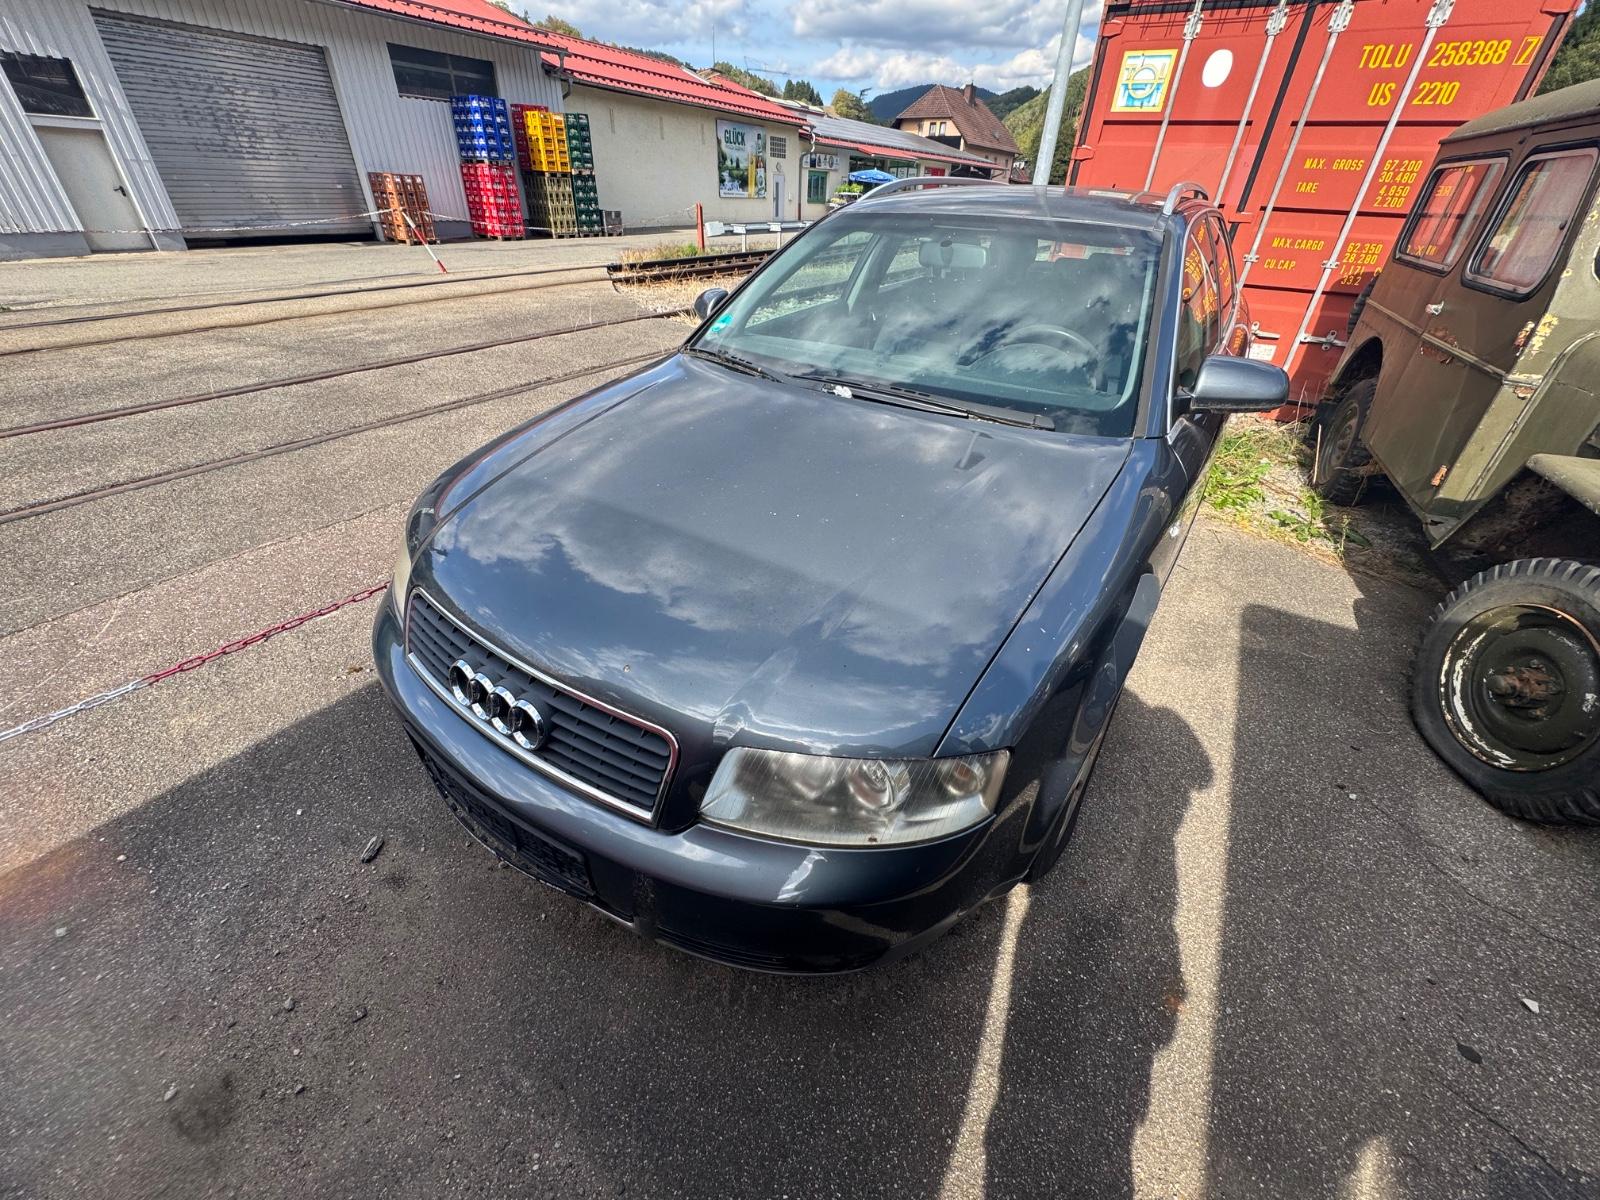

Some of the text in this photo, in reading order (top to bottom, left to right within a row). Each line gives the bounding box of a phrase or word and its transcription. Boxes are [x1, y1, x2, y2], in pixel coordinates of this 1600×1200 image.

[1359, 37, 1539, 69] TOLU 258388 7
[1367, 82, 1460, 106] US 2210
[725, 128, 745, 146] GLÜCK
[1304, 158, 1422, 171] MAX. GROSS 67.200
[1296, 182, 1319, 193] TARE
